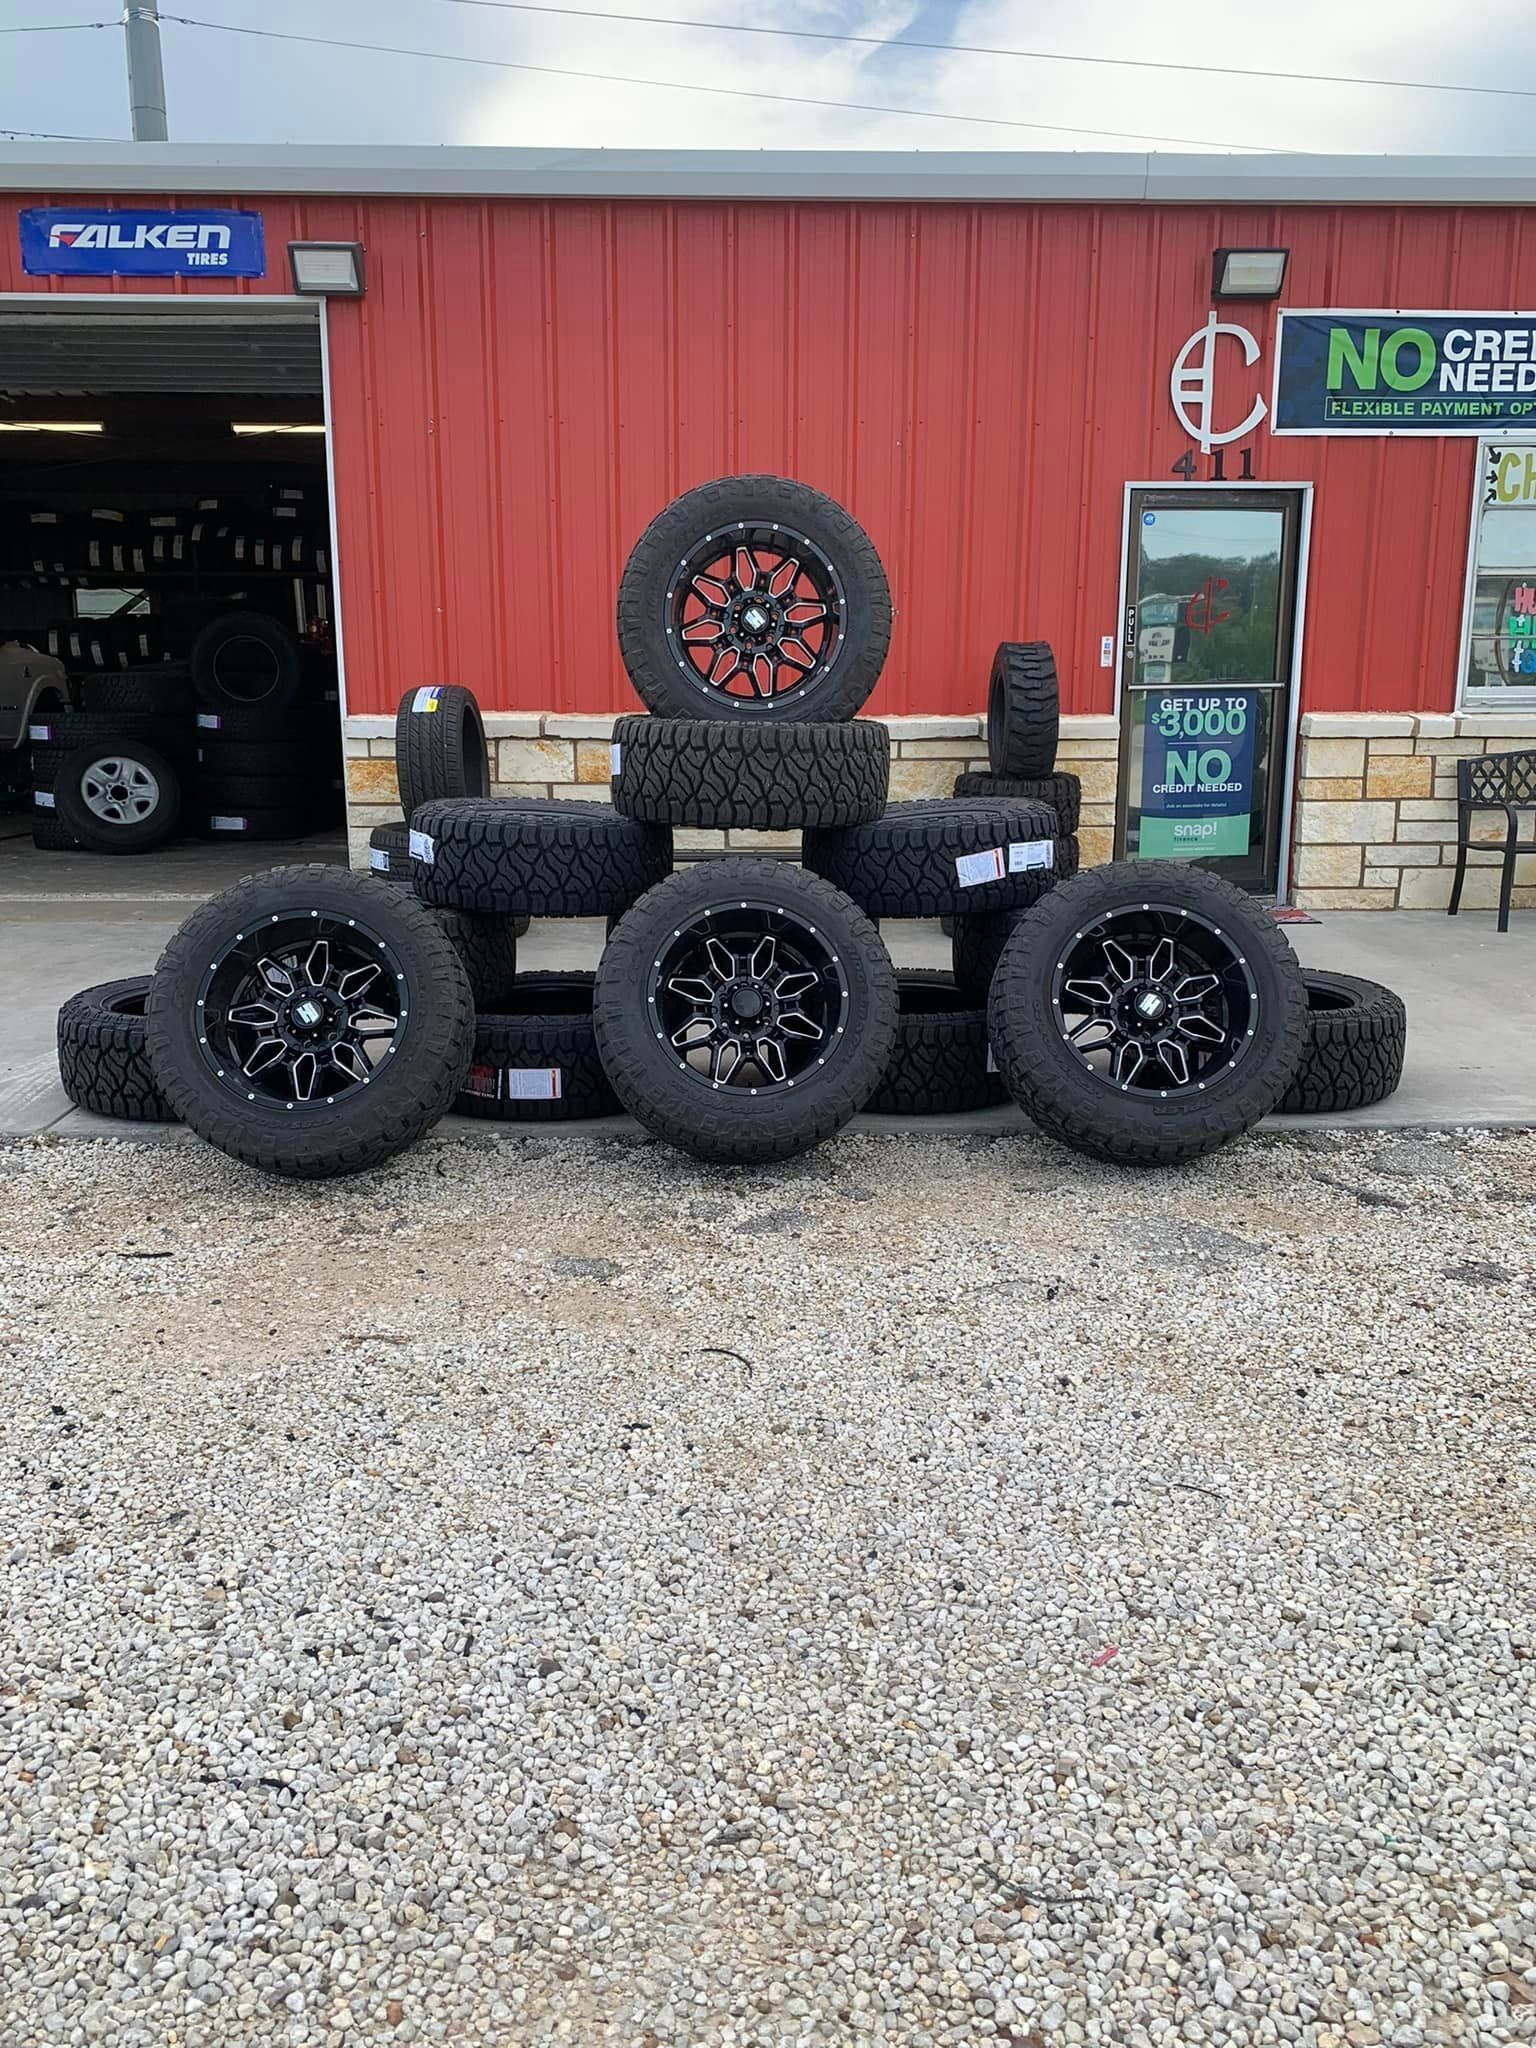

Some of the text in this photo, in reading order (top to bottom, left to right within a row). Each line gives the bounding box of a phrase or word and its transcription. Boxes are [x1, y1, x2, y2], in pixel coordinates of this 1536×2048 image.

[48, 224, 231, 249] FALKEN
[187, 253, 228, 265] TIRES
[1326, 328, 1437, 392] NO
[1331, 402, 1415, 416] FLEXIBLE
[1421, 402, 1502, 416] PAYMENT
[1171, 448, 1256, 481] 411
[1127, 609, 1136, 643] PULL
[1160, 698, 1248, 712] GET UP TO
[1151, 708, 1247, 739] $3,000
[1165, 749, 1232, 786] NO
[1152, 783, 1243, 794] CREDIT NEEDED
[1174, 822, 1217, 839] snap!
